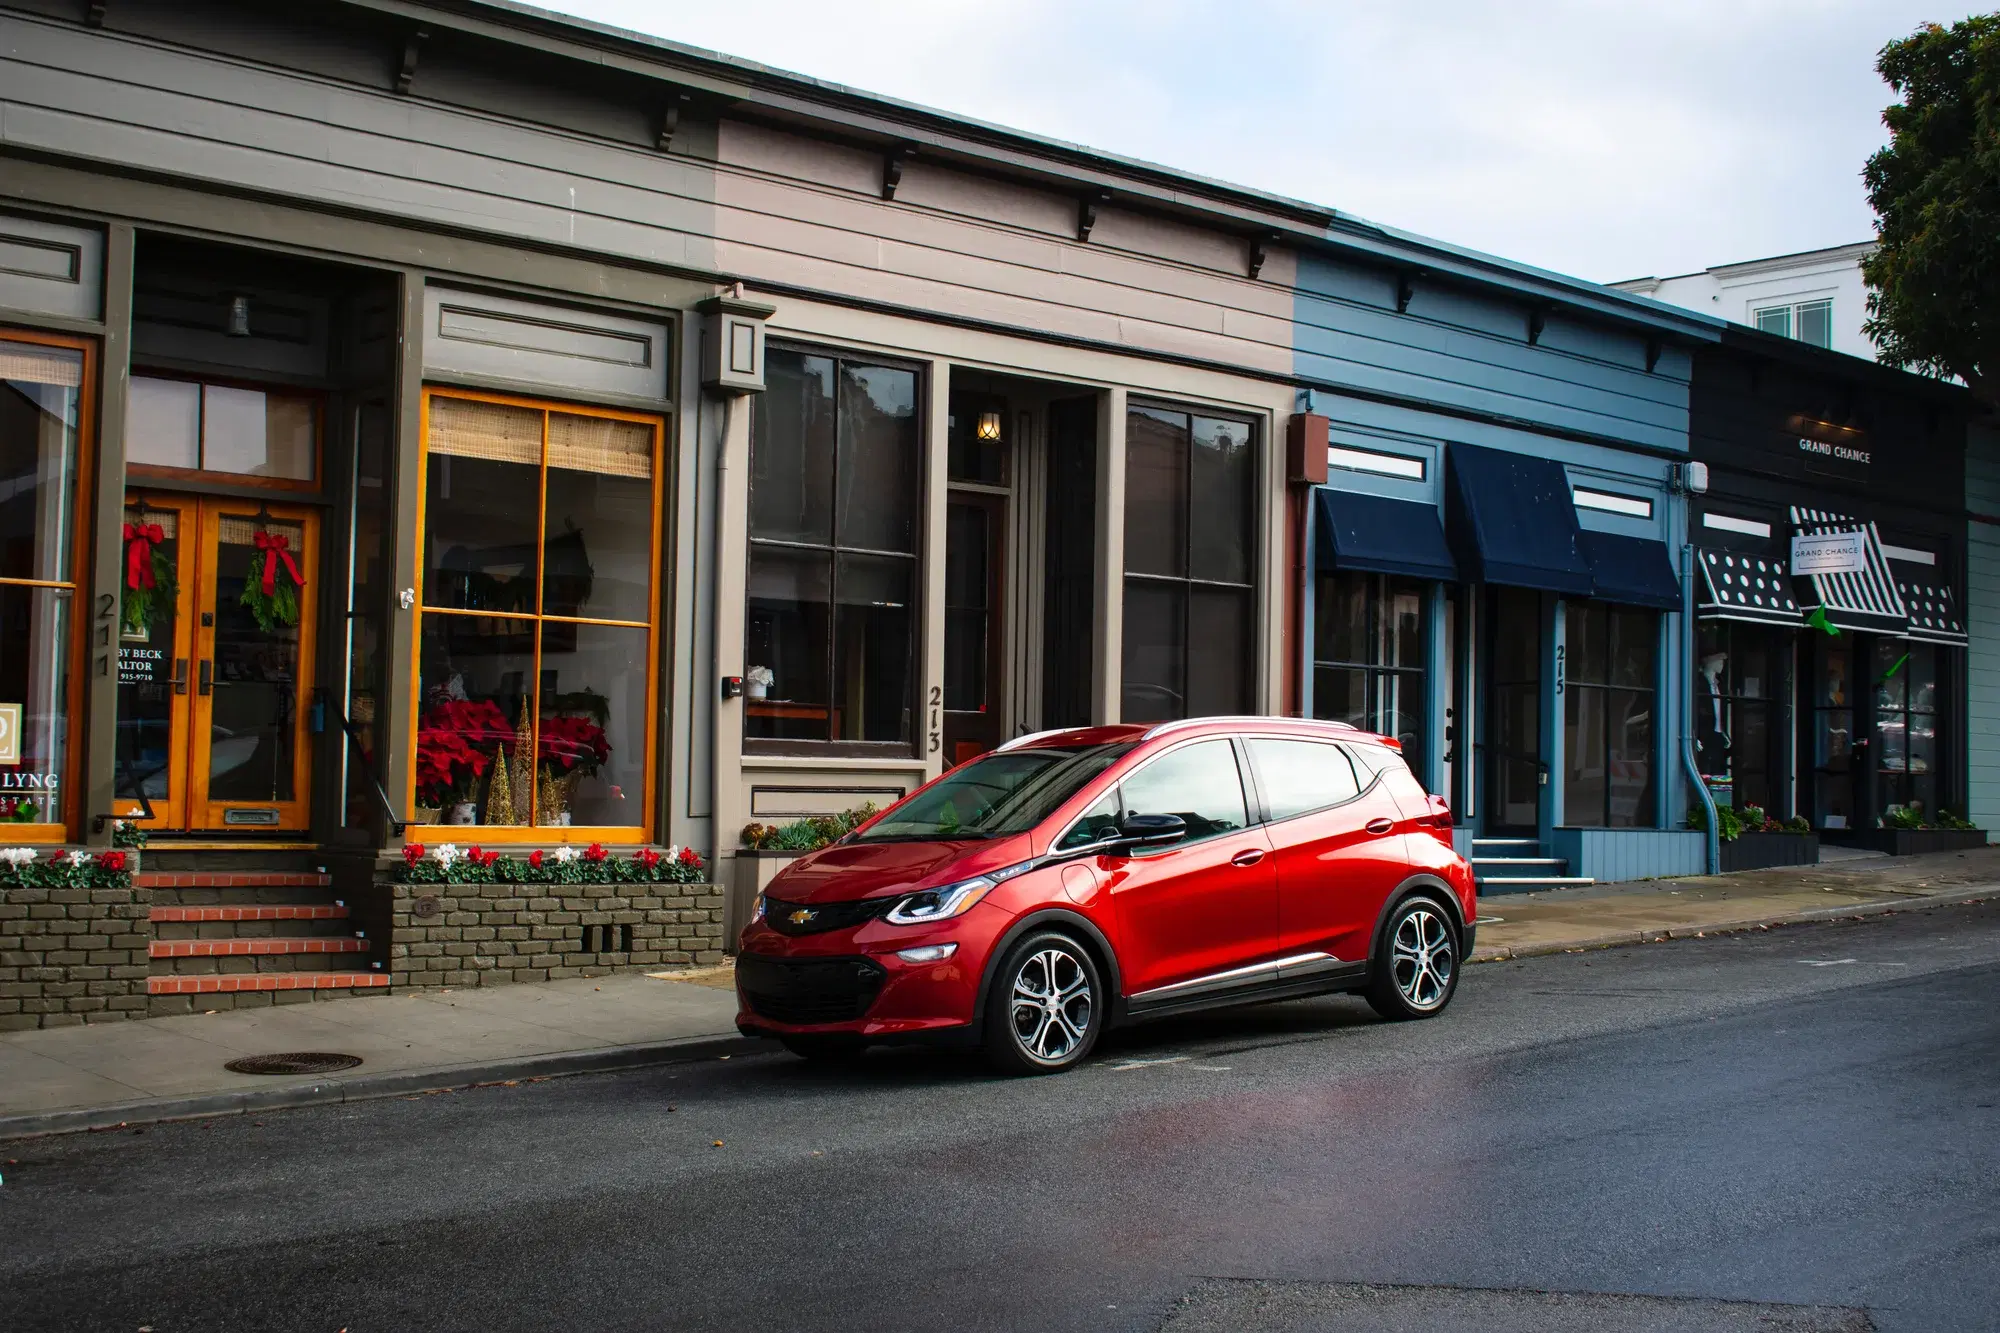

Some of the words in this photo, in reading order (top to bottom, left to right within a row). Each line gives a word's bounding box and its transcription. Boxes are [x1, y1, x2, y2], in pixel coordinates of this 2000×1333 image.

[1799, 439, 1831, 455] GRAND
[1834, 446, 1871, 463] CHANCE
[1795, 549, 1822, 557] GRAND
[1825, 547, 1858, 555] CHANCE
[133, 649, 162, 659] BECK
[1556, 645, 1564, 694] 215
[929, 686, 941, 752] 213
[3, 773, 58, 788] LYNG
